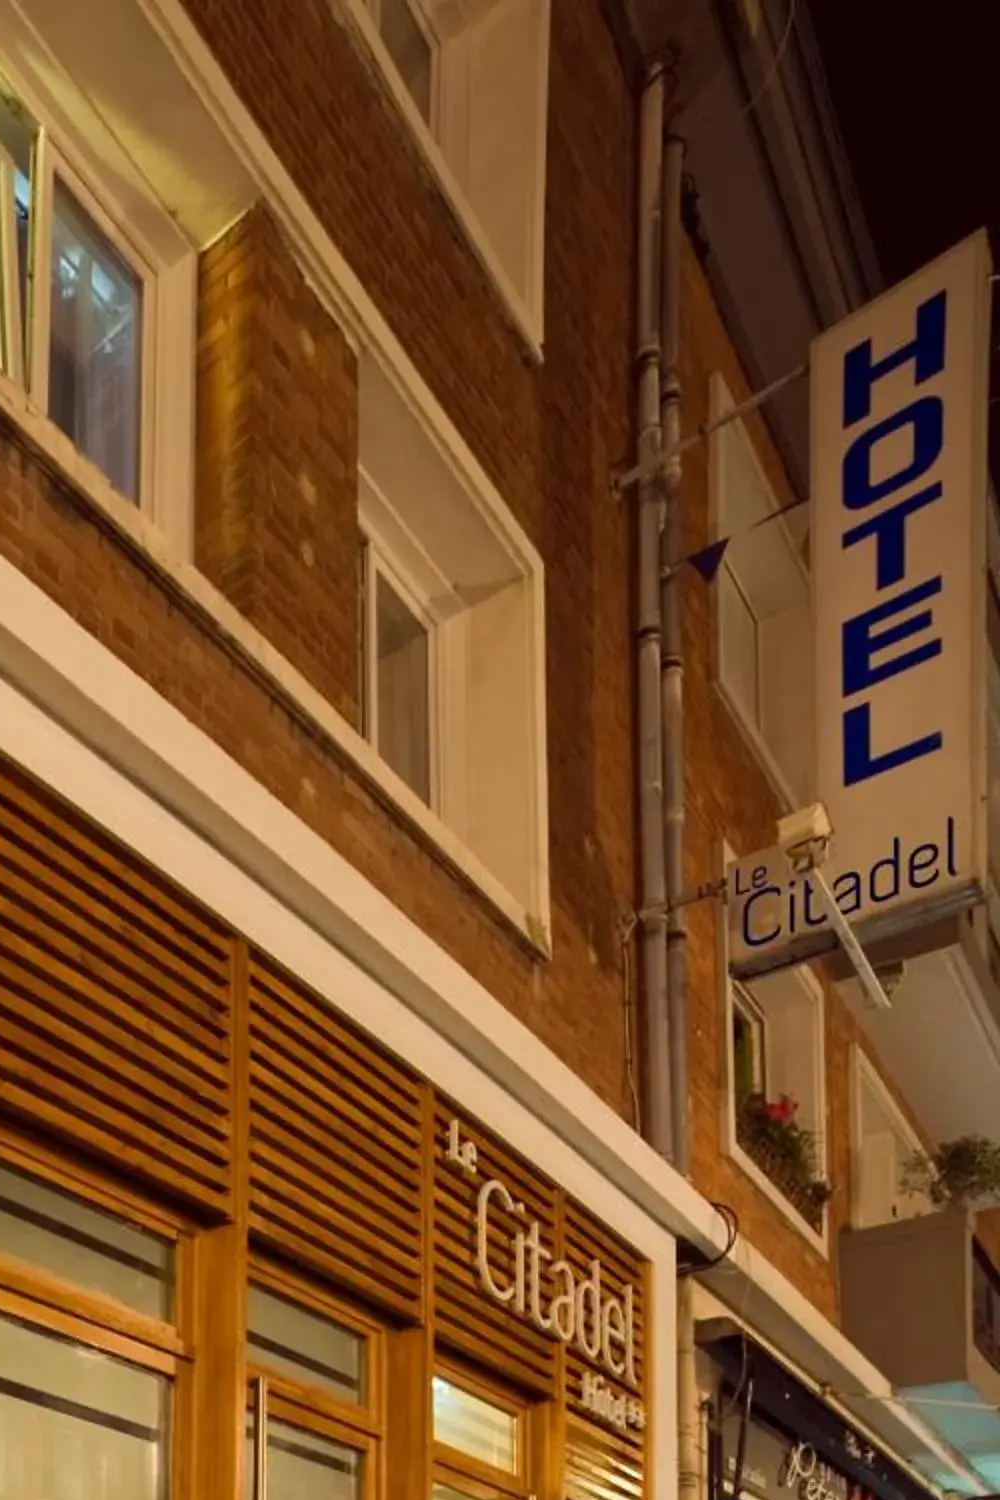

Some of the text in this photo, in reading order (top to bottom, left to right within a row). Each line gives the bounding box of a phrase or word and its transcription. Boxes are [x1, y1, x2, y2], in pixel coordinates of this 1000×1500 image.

[842, 289, 947, 787] HOTEL
[735, 866, 767, 895] Le
[743, 816, 957, 946] Citadel
[447, 1119, 477, 1174] Le
[477, 1179, 637, 1387] Citadel
